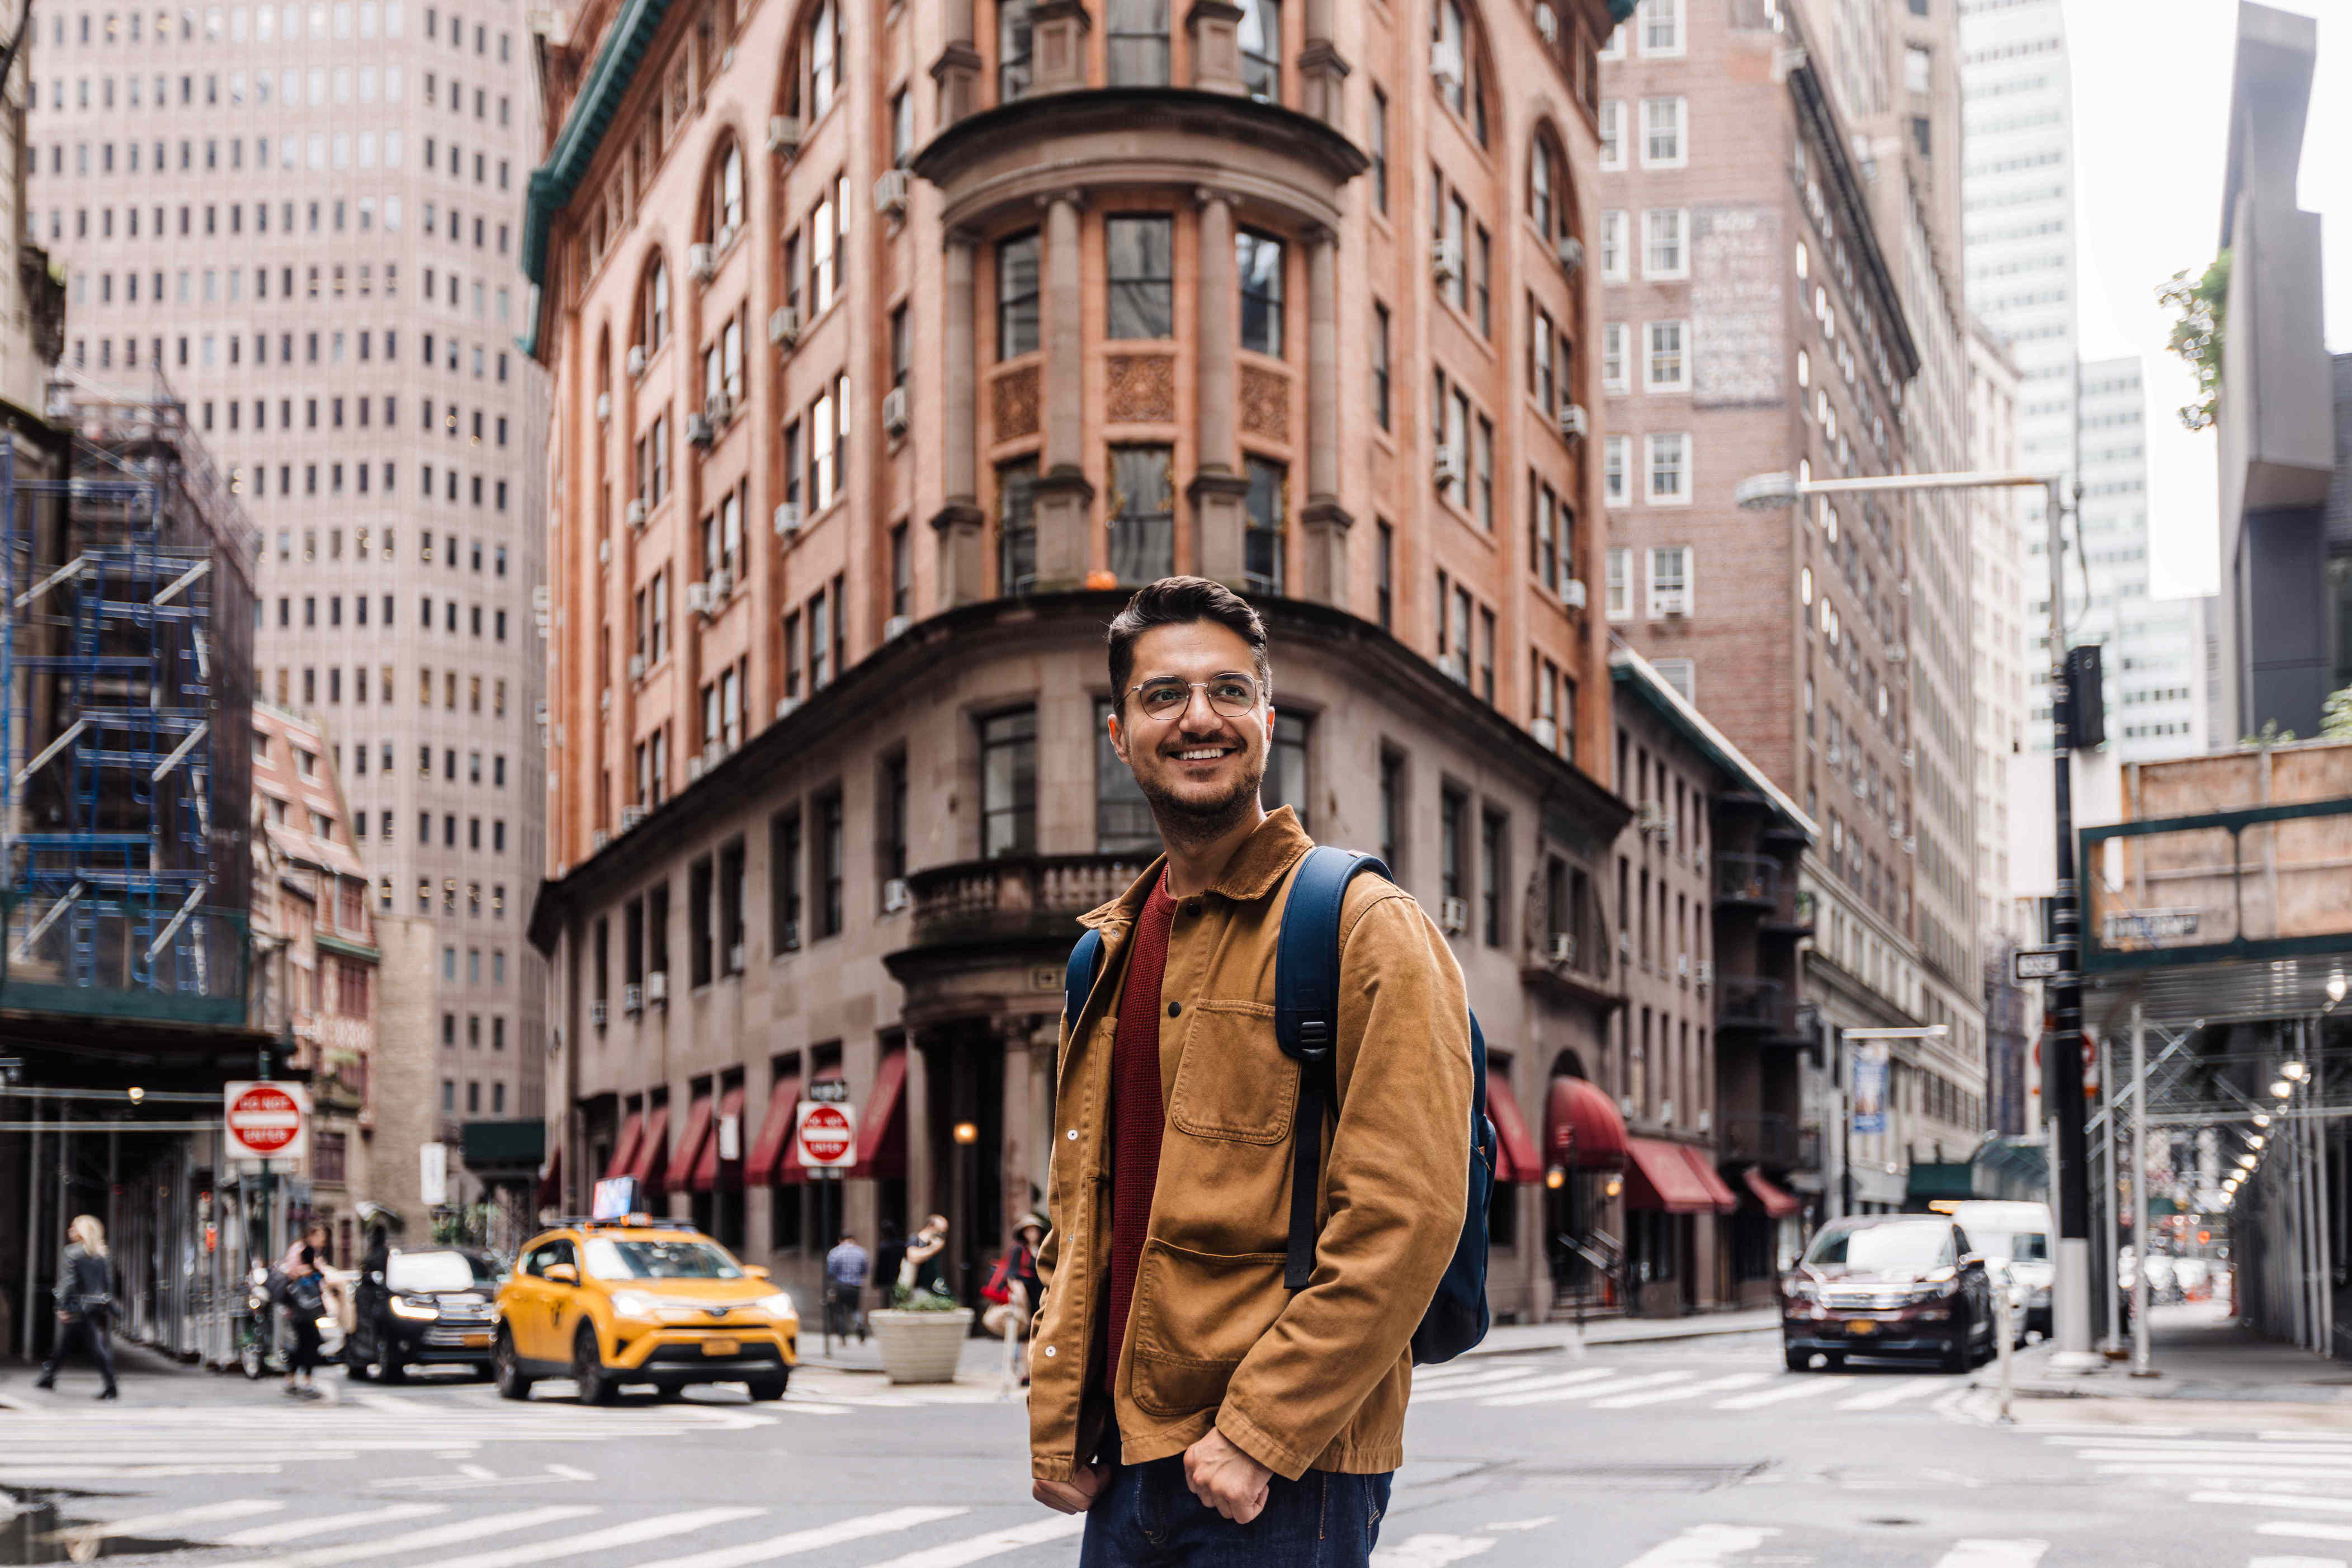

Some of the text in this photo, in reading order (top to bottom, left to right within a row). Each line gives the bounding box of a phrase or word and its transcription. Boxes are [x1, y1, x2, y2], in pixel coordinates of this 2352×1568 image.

[239, 1096, 291, 1110] DO NOT
[805, 1116, 845, 1126] DO NOT
[243, 1128, 290, 1143] ENTER
[810, 1143, 843, 1154] ENTER
